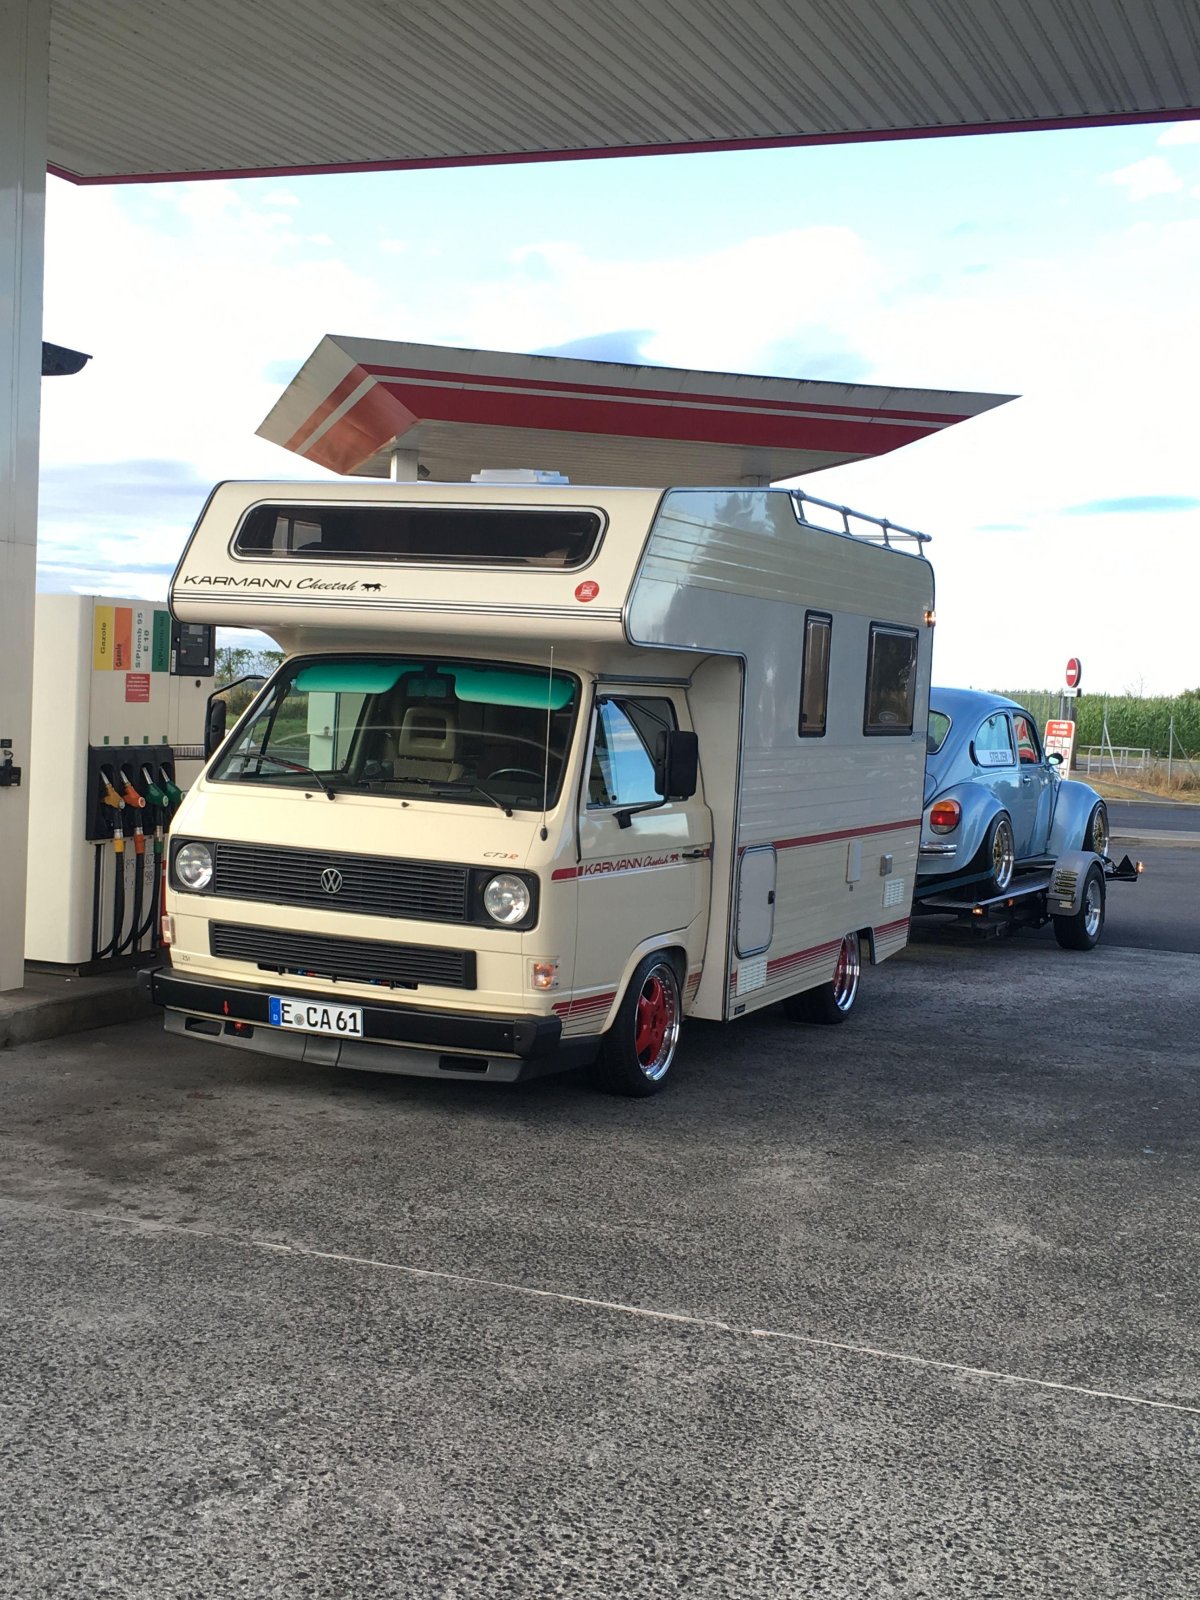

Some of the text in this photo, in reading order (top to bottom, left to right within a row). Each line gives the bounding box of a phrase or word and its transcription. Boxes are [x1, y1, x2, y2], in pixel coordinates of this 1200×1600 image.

[183, 575, 360, 592] KARMANN Cheetah
[584, 855, 669, 876] KARMANN Cheetah
[281, 1003, 360, 1034] E CA 61
